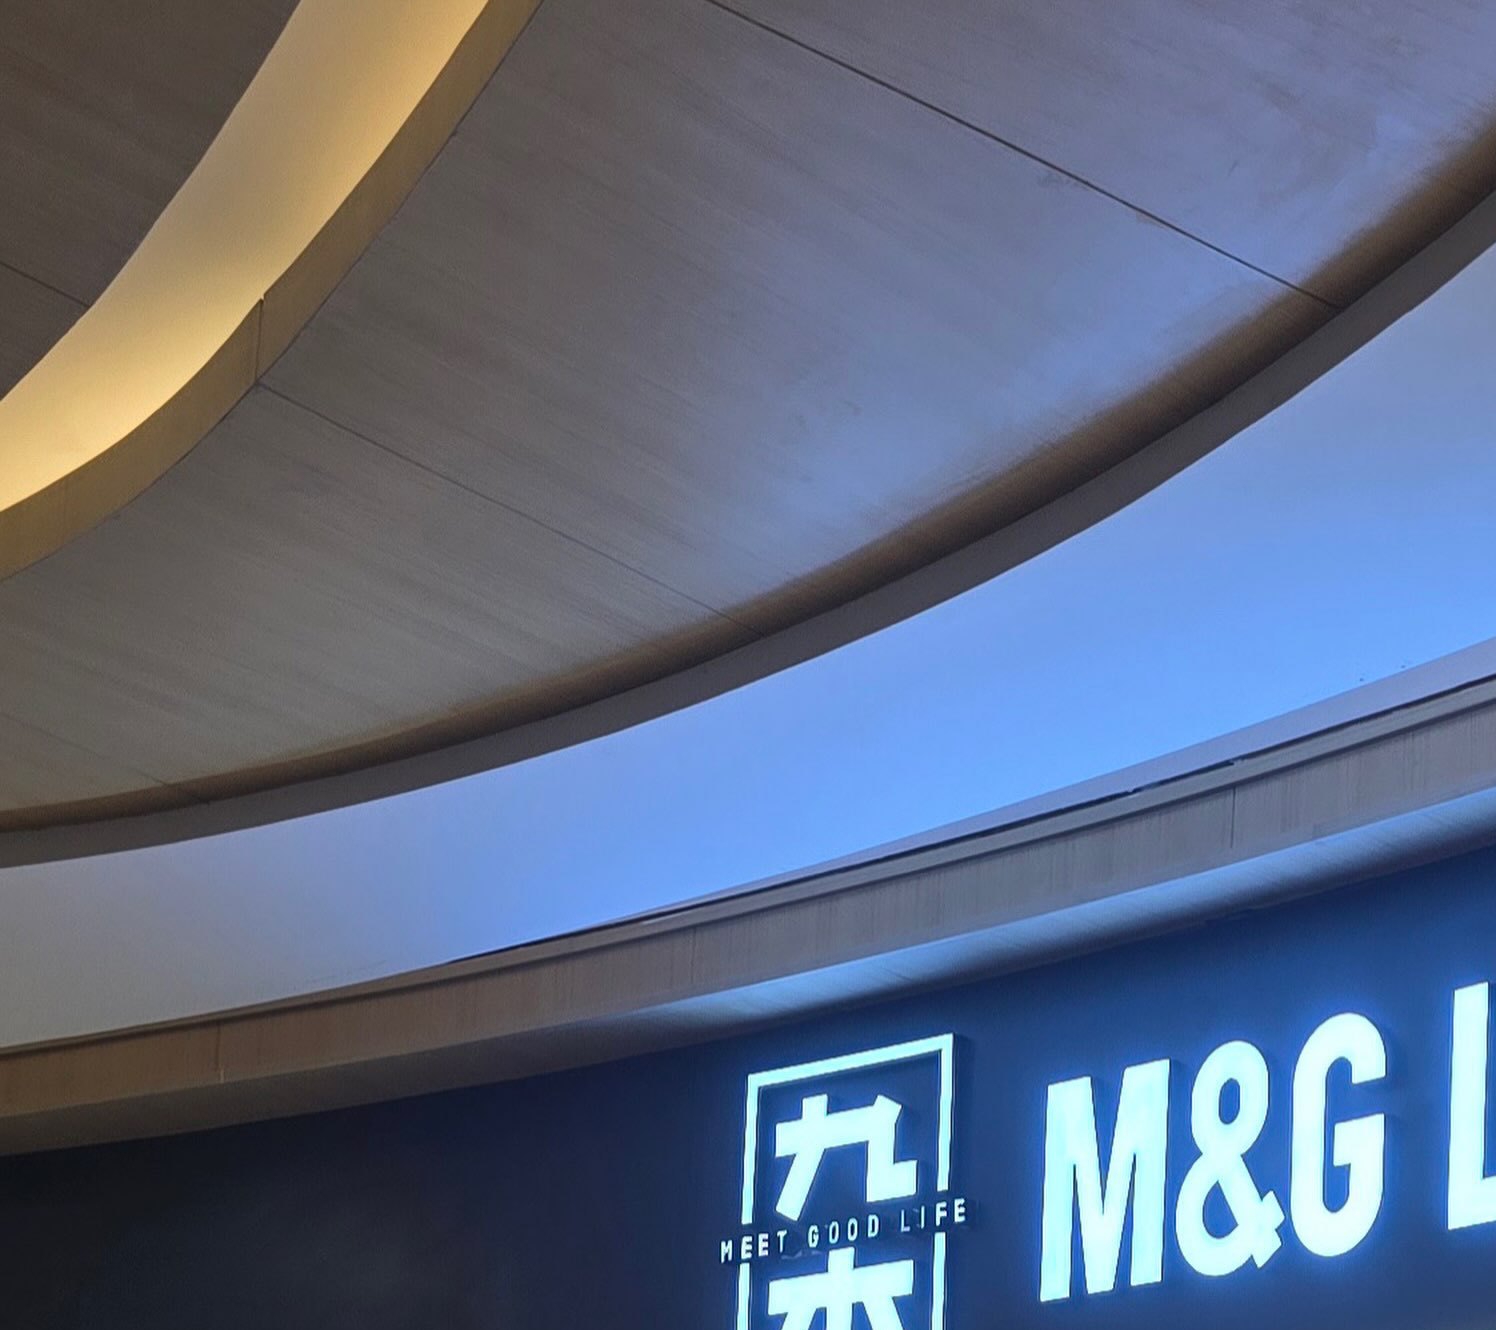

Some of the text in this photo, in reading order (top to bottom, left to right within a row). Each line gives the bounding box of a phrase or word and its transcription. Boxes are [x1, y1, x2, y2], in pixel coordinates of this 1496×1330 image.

[719, 1198, 969, 1263] MEET GOOD LIFE
[1040, 1012, 1387, 1304] M&G
